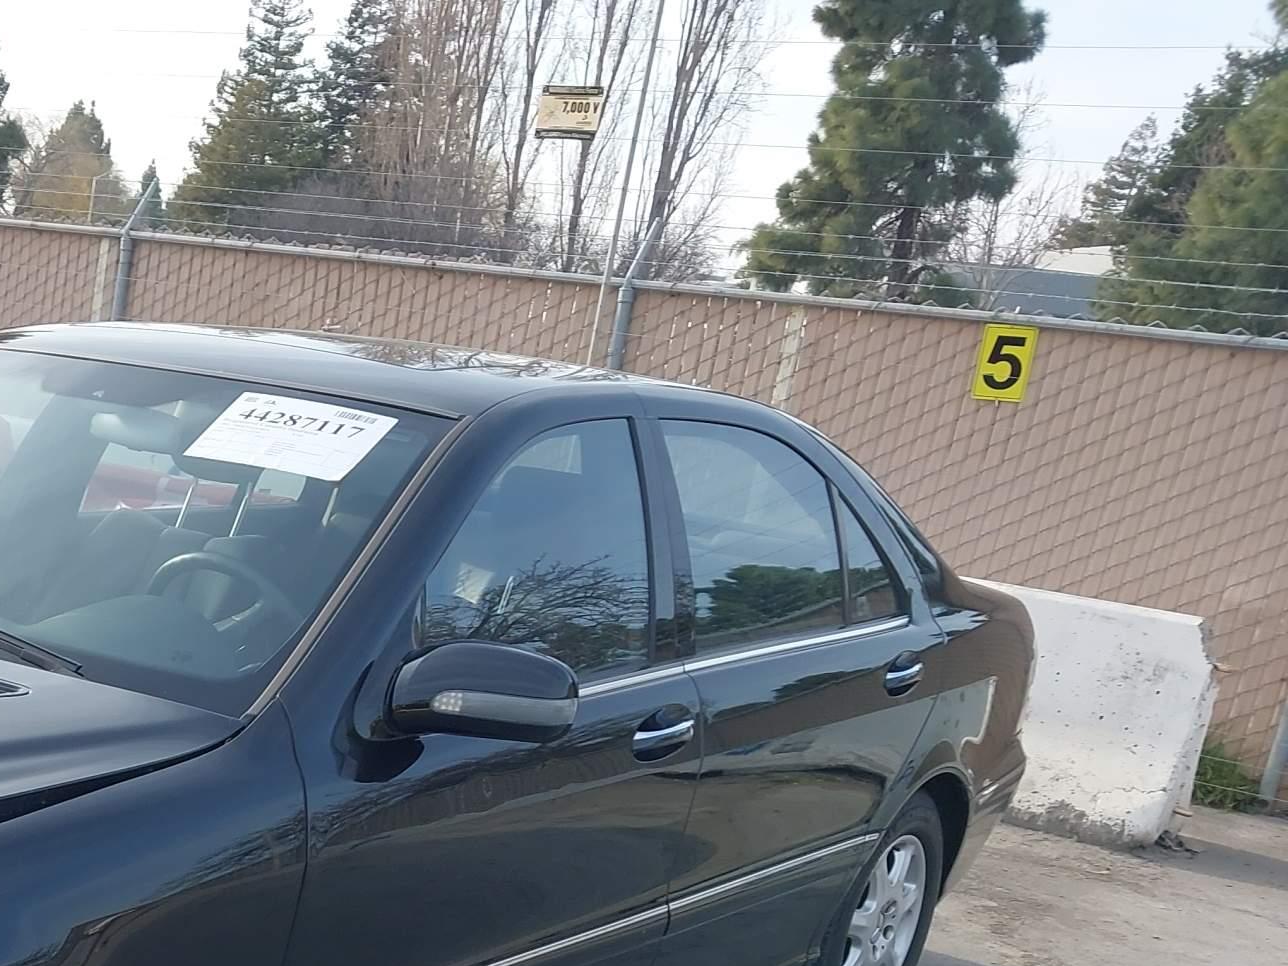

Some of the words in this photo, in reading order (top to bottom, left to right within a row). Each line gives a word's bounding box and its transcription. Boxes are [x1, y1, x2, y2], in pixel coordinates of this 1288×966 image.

[562, 101, 590, 114] 7,000
[982, 335, 1029, 391] 5
[239, 407, 366, 438] 44287117
